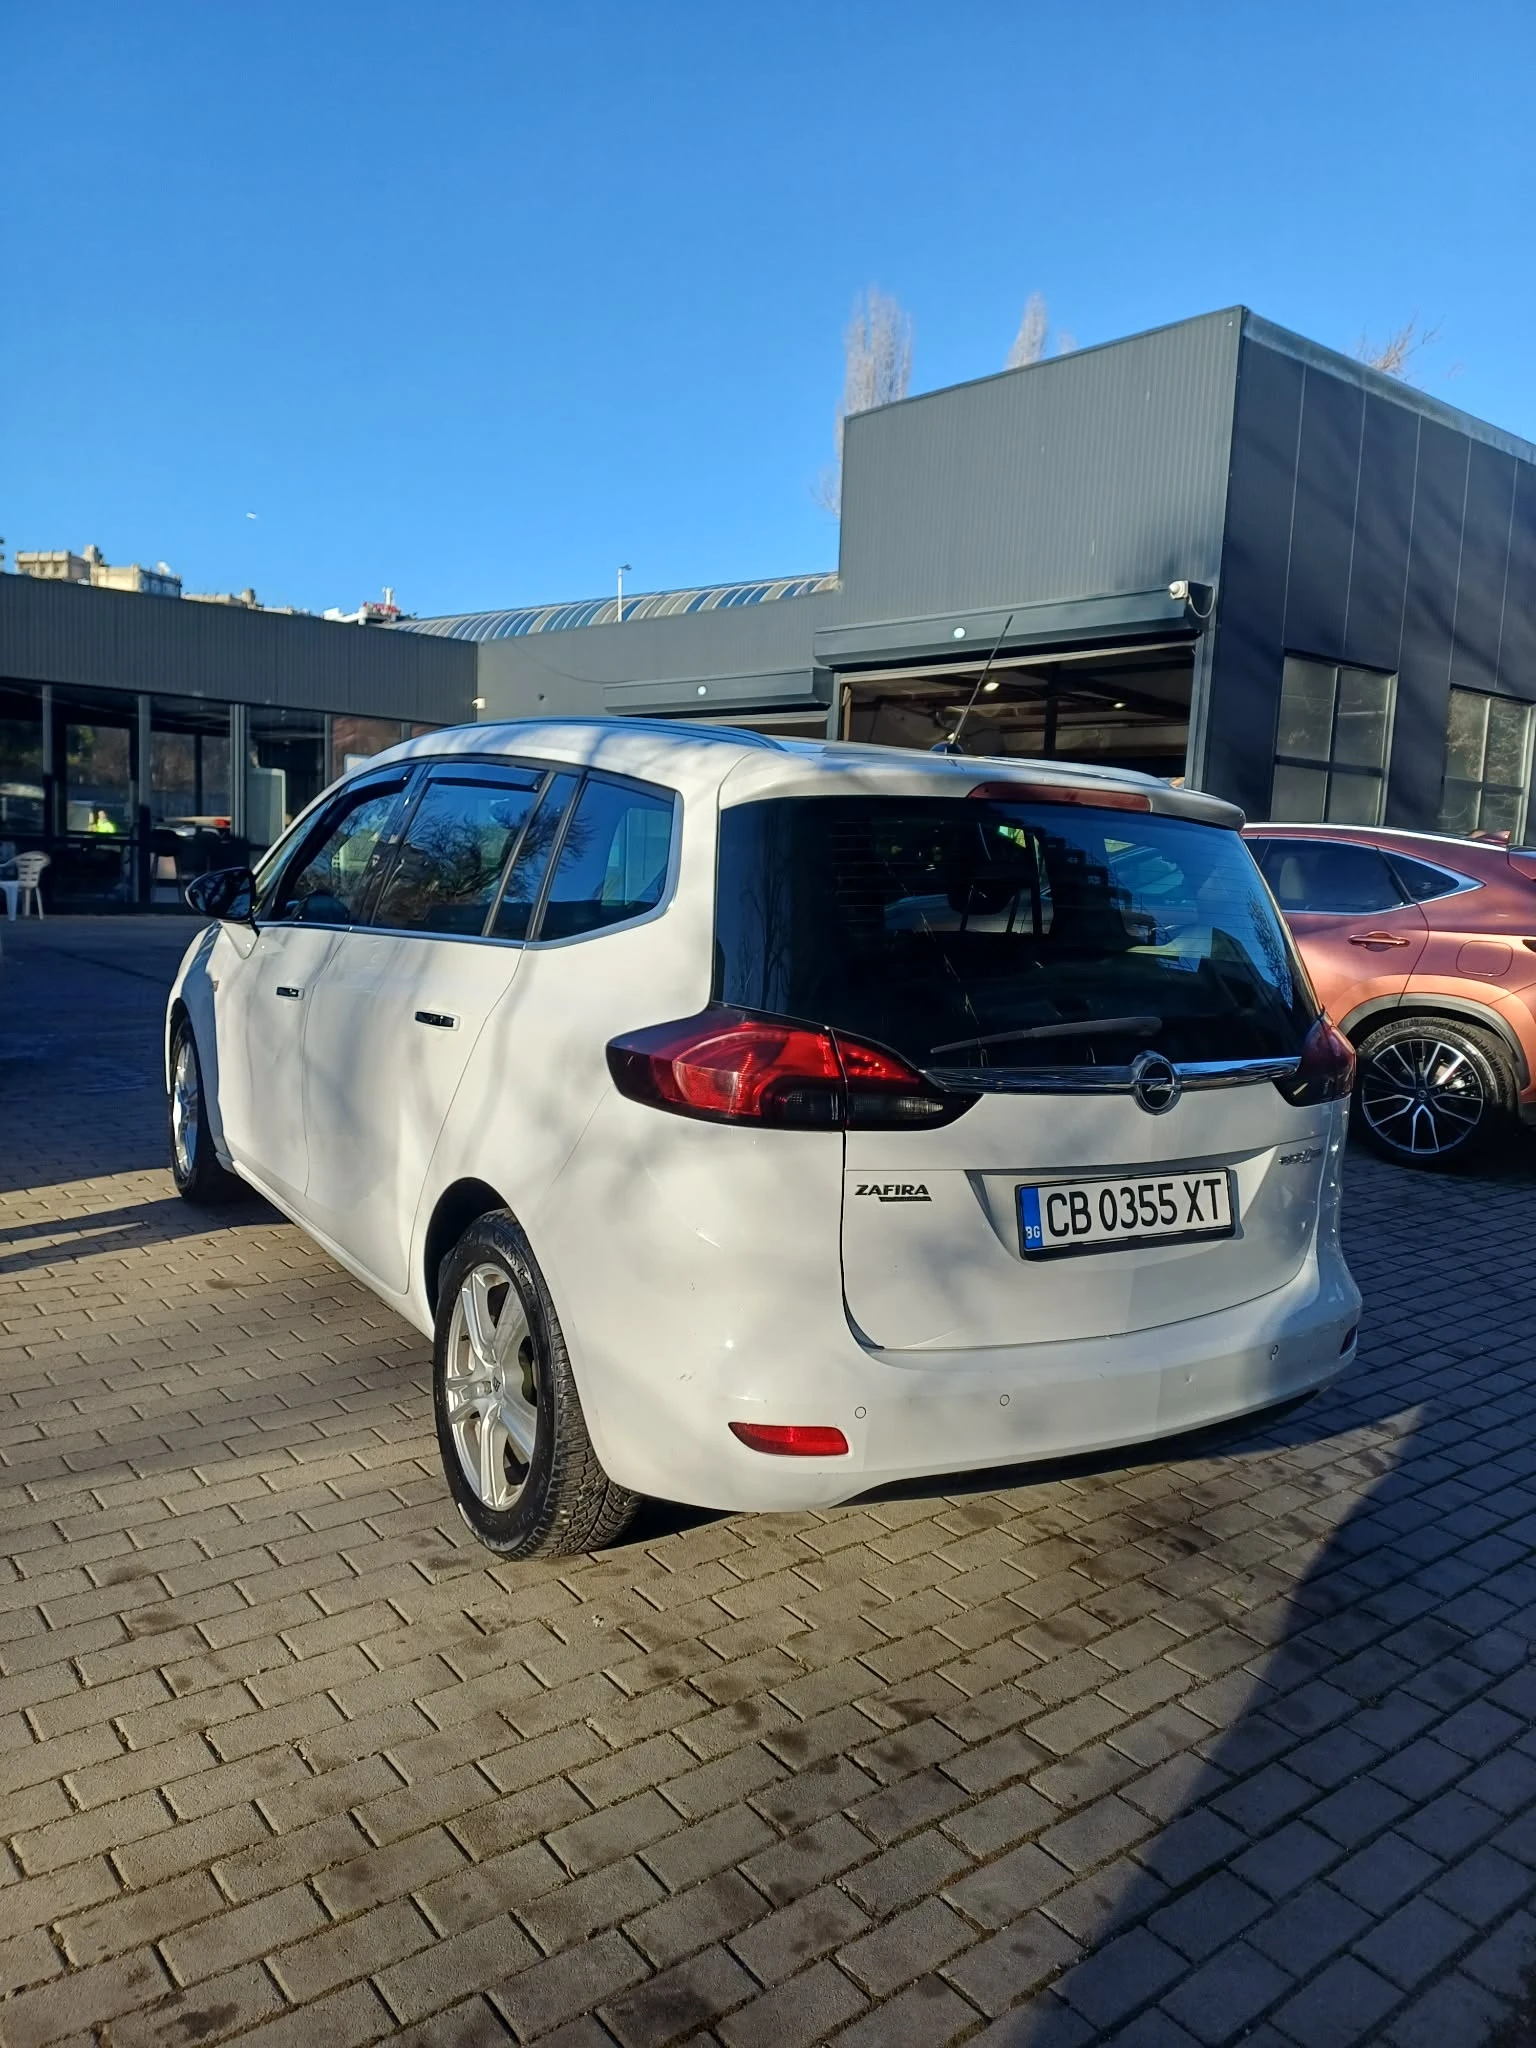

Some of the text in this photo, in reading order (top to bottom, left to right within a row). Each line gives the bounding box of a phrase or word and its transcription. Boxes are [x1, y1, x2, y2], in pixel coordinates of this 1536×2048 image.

[855, 1184, 930, 1196] ZAFIRA
[1046, 1178, 1222, 1237] CB 0355 XT
[1025, 1226, 1041, 1239] BG
